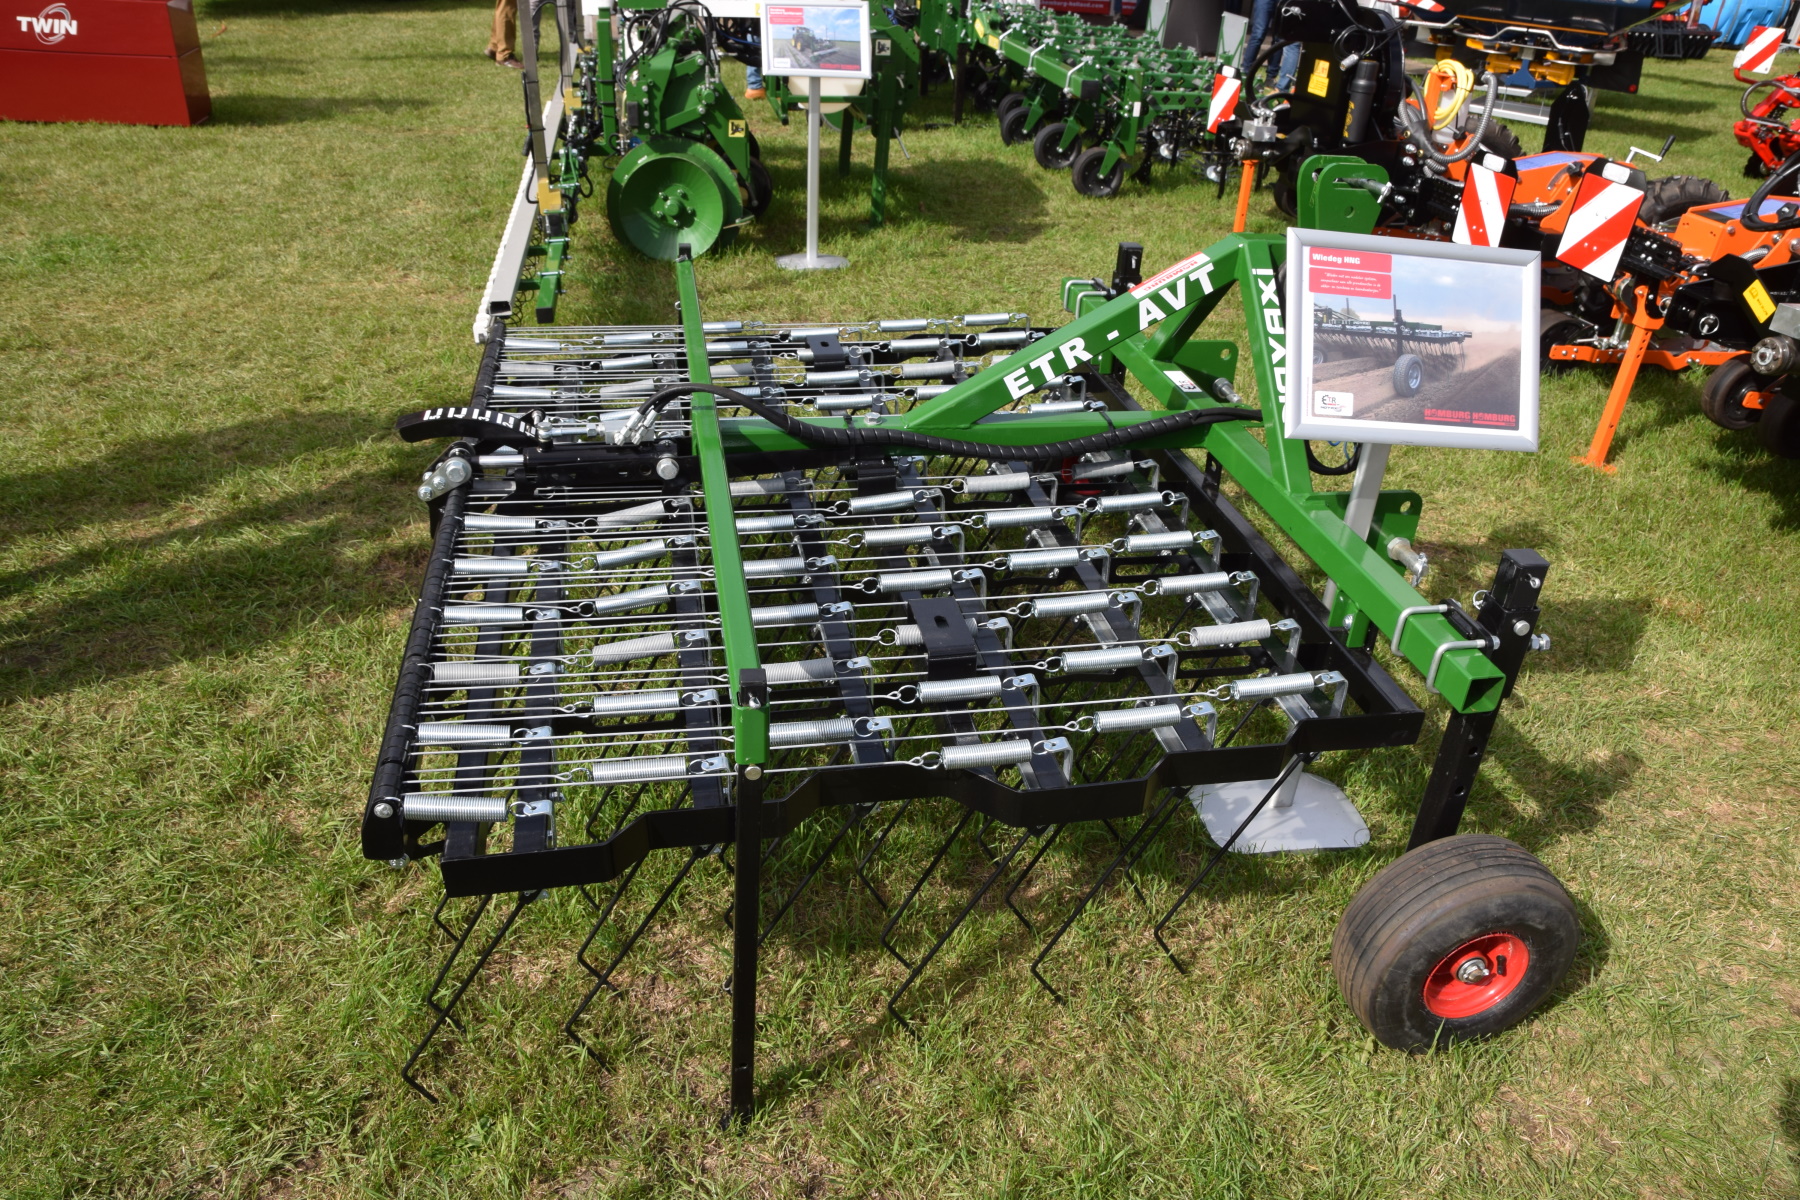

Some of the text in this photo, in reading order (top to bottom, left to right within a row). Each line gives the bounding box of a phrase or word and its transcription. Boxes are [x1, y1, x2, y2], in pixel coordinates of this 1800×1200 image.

[16, 16, 78, 36] TWIN
[1312, 253, 1342, 264] Wiedeg
[1003, 337, 1093, 400] ETR
[1138, 262, 1215, 331] AVT
[1424, 408, 1516, 423] HOMBURG HOMBURG
